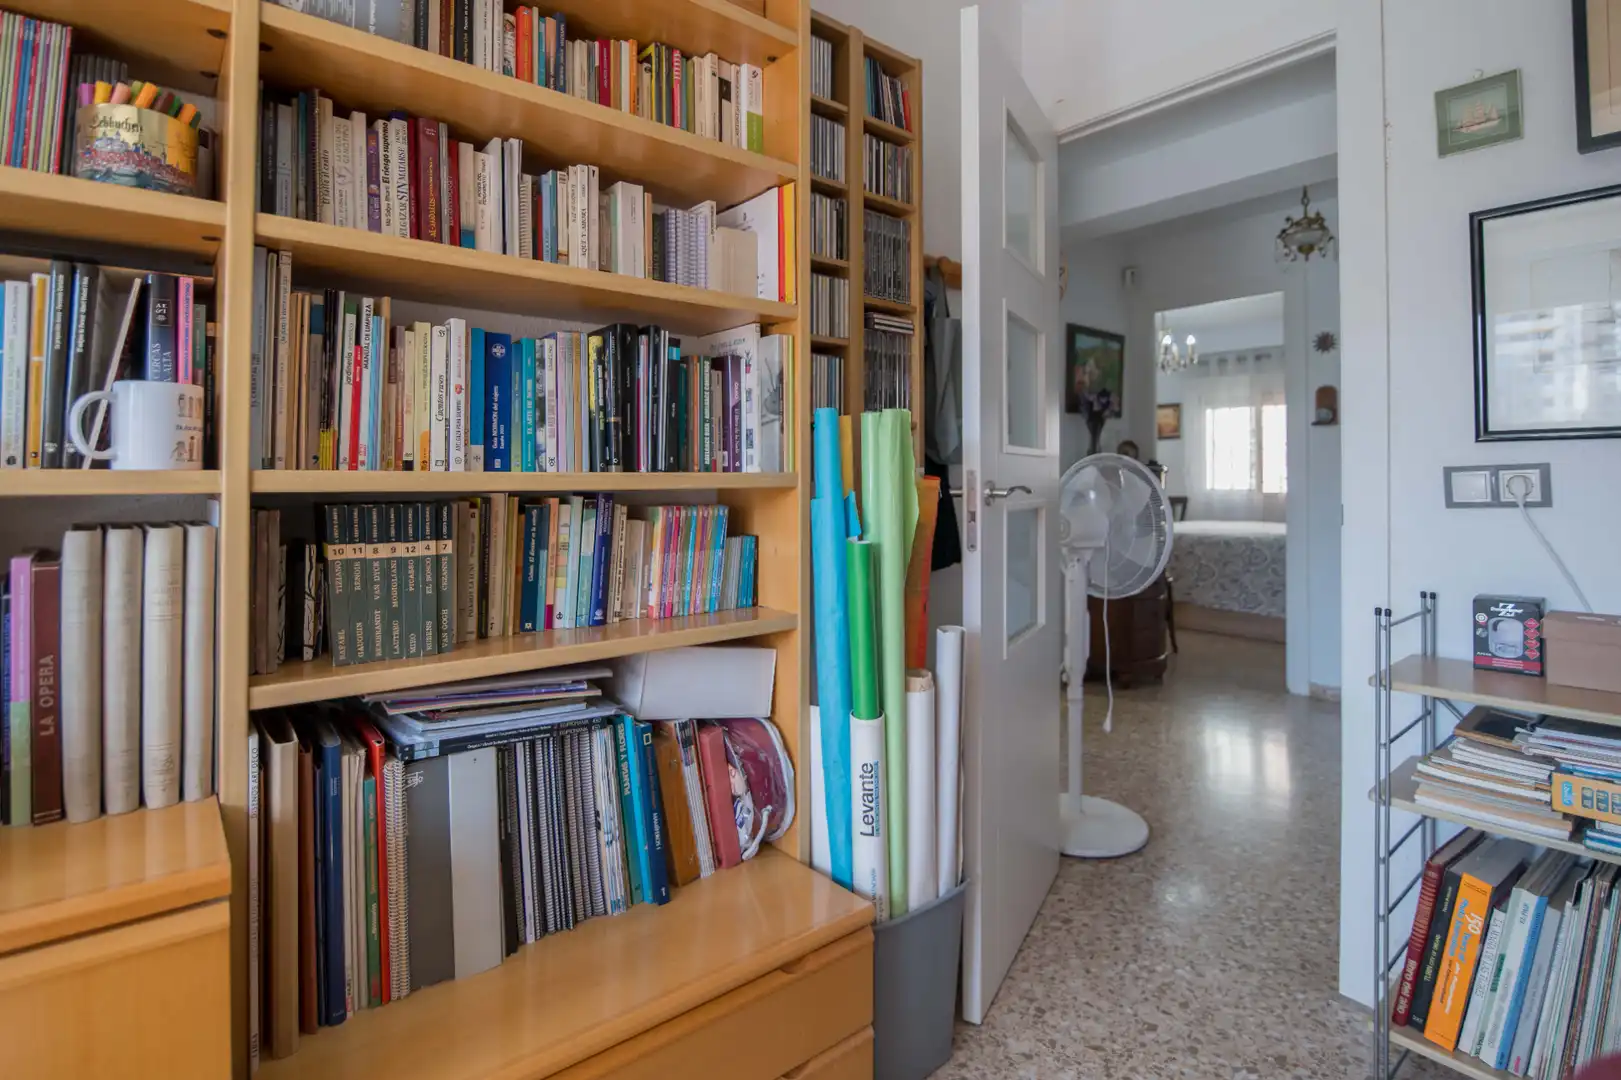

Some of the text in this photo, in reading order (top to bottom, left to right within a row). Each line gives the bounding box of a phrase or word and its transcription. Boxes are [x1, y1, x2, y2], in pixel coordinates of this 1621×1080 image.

[382, 122, 390, 153] supremo
[382, 154, 390, 176] riesgo
[397, 147, 406, 180] MATARSE
[396, 180, 408, 202] SIN
[162, 351, 172, 373] ALTA
[436, 394, 444, 422] Cuentos
[426, 584, 432, 594] EL
[337, 629, 346, 660] RAFAEL
[356, 622, 364, 658] GAUGUIN
[39, 655, 54, 736] LA OPERA
[618, 723, 627, 753] FLORES
[620, 762, 631, 796] PLANTAS
[859, 763, 874, 837] Levante
[1465, 912, 1484, 934] 150
[1405, 960, 1417, 980] libro
[1402, 982, 1411, 995] del
